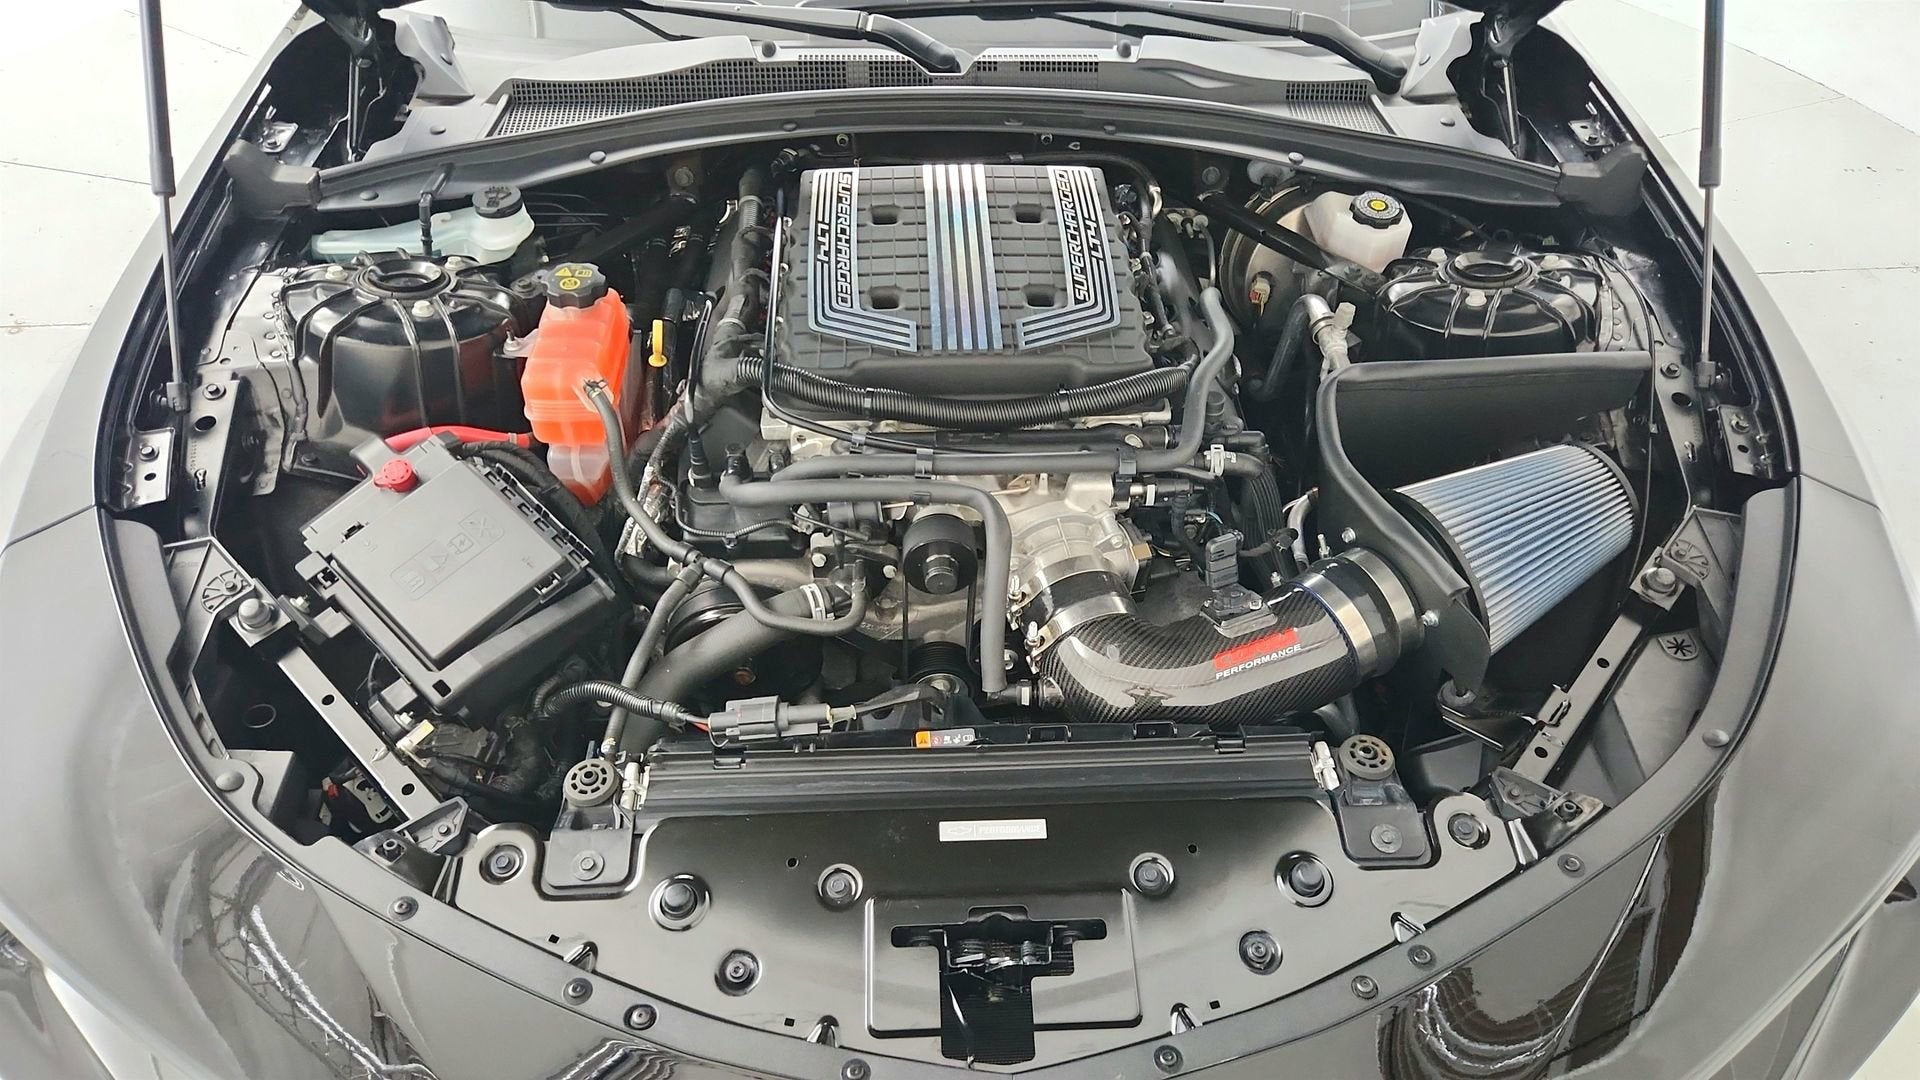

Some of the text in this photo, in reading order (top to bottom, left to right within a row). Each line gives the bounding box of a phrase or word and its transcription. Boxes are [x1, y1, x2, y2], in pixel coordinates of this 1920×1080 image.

[817, 223, 829, 262] LT4
[837, 172, 852, 308] SUPERCHARGED
[1055, 170, 1089, 301] SUPERCHARGED
[1085, 220, 1104, 260] LT4
[1215, 644, 1302, 680] PERFORMANCE
